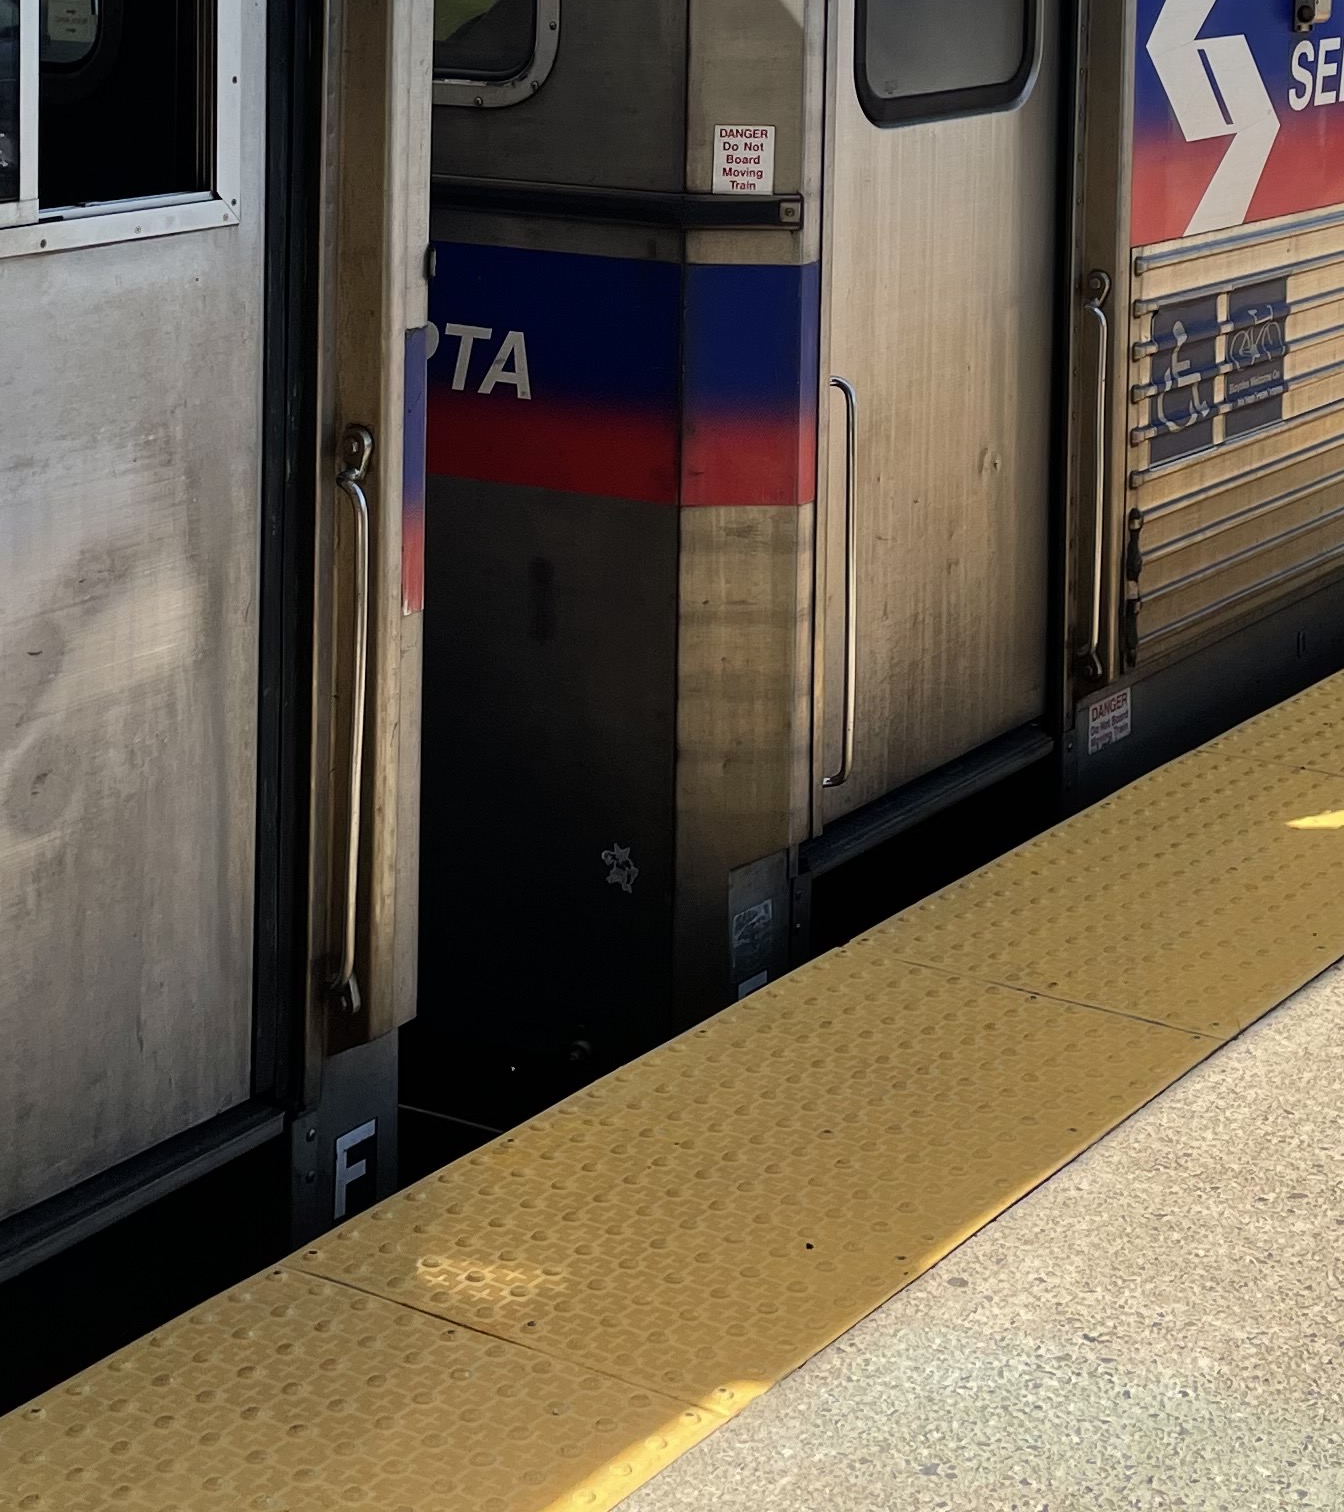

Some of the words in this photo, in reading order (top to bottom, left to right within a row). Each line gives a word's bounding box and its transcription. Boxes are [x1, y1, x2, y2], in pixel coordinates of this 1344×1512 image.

[719, 128, 769, 139] DANGER
[722, 141, 739, 152] Do
[743, 141, 764, 152] Not
[726, 154, 761, 165] Board
[721, 167, 764, 180] Moving
[729, 180, 757, 191] Train
[426, 320, 532, 400] TA
[1091, 692, 1128, 722] DANGER
[333, 1118, 376, 1221] F
